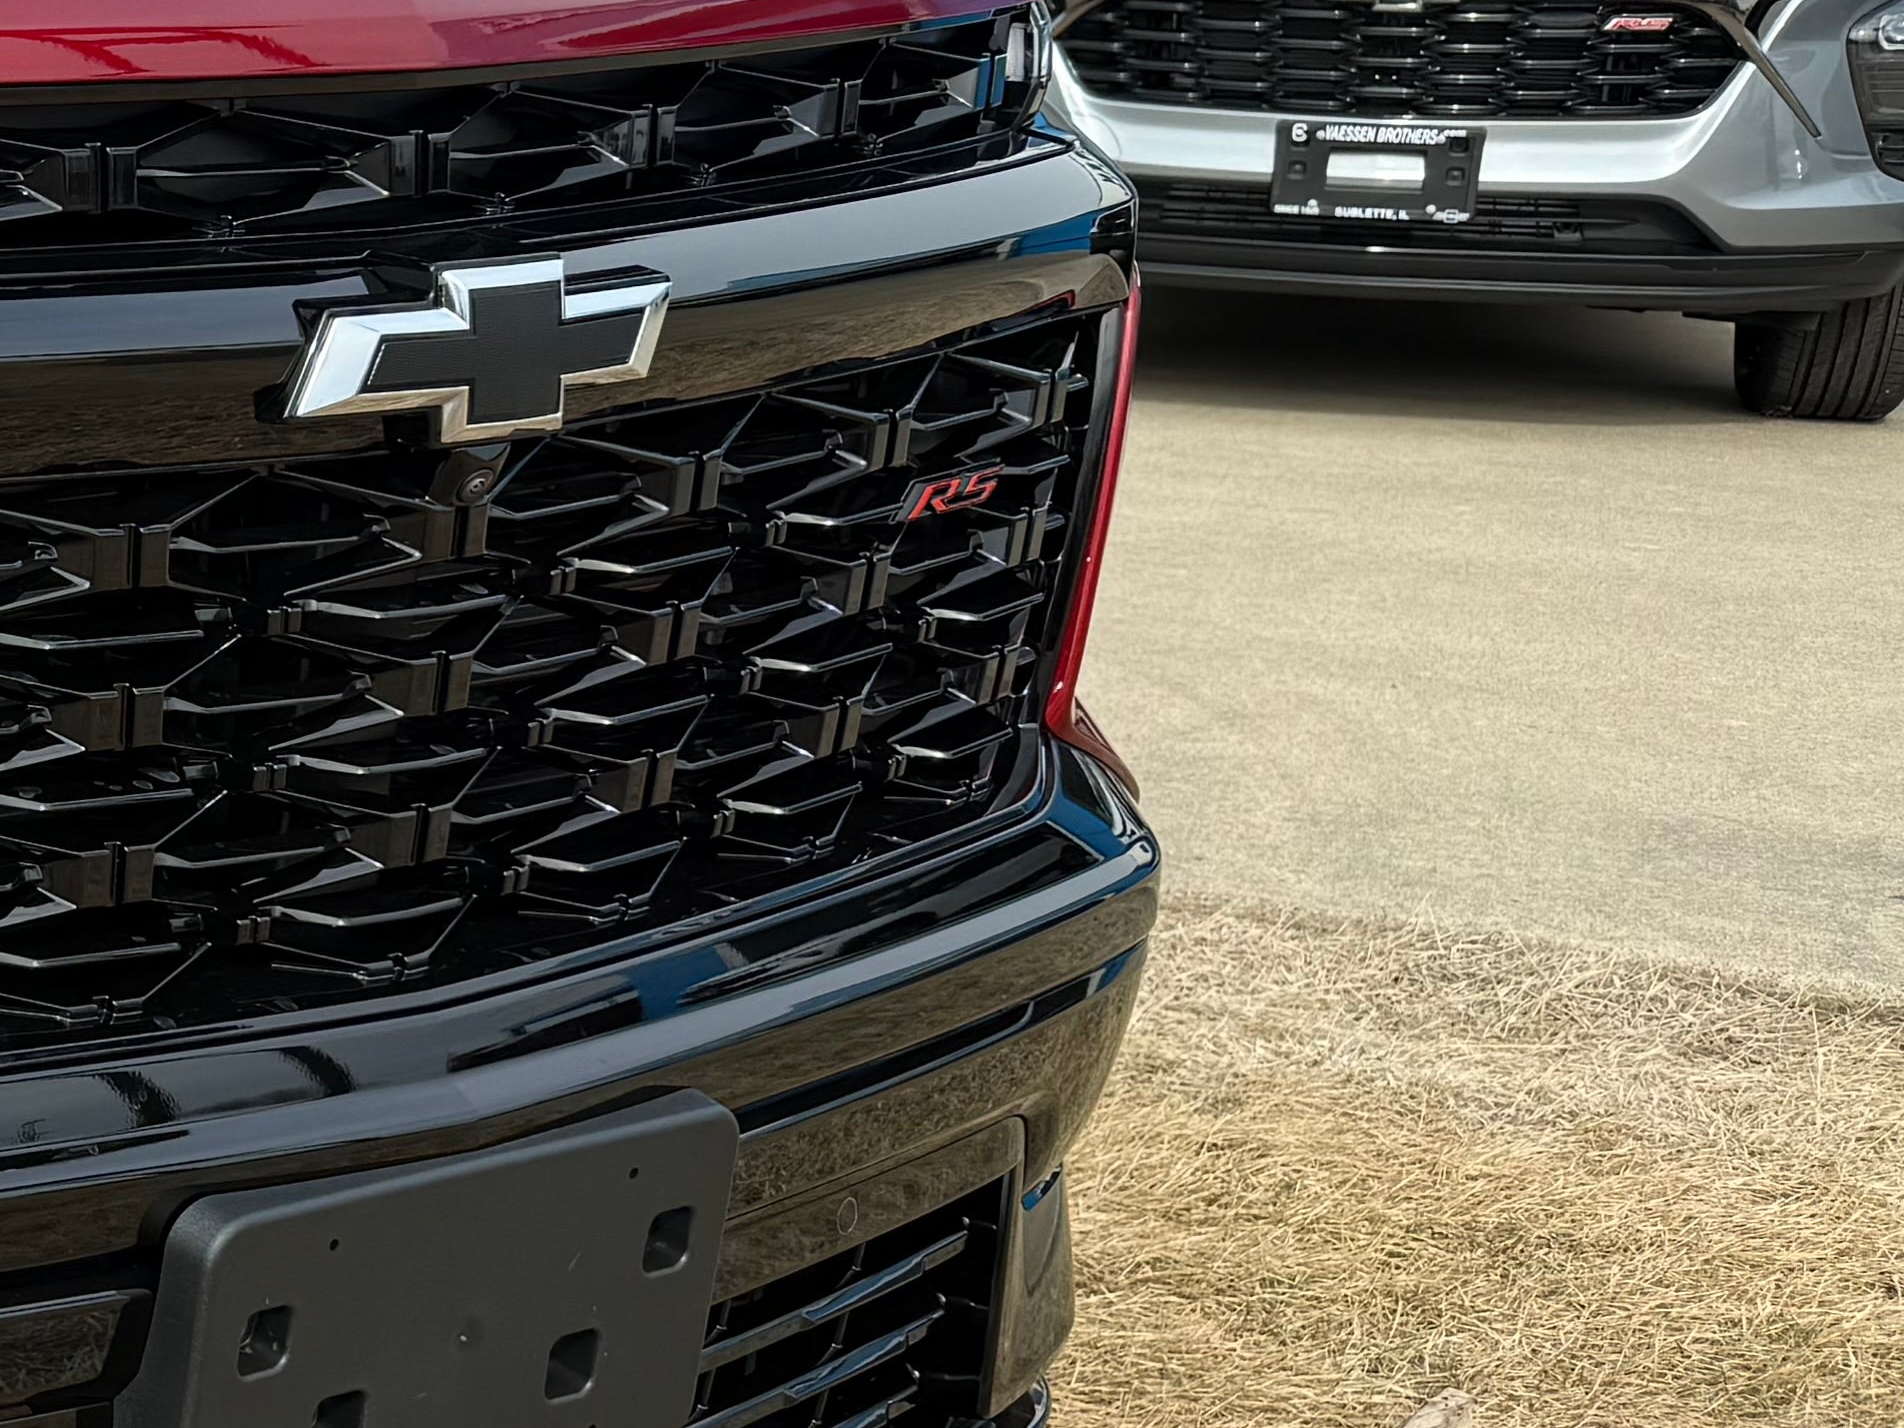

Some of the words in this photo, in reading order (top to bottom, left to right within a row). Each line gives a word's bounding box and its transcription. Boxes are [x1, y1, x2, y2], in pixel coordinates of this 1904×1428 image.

[1324, 123, 1377, 143] VAESSEN
[1376, 126, 1438, 146] BROTHERS
[906, 463, 1005, 523] RS
